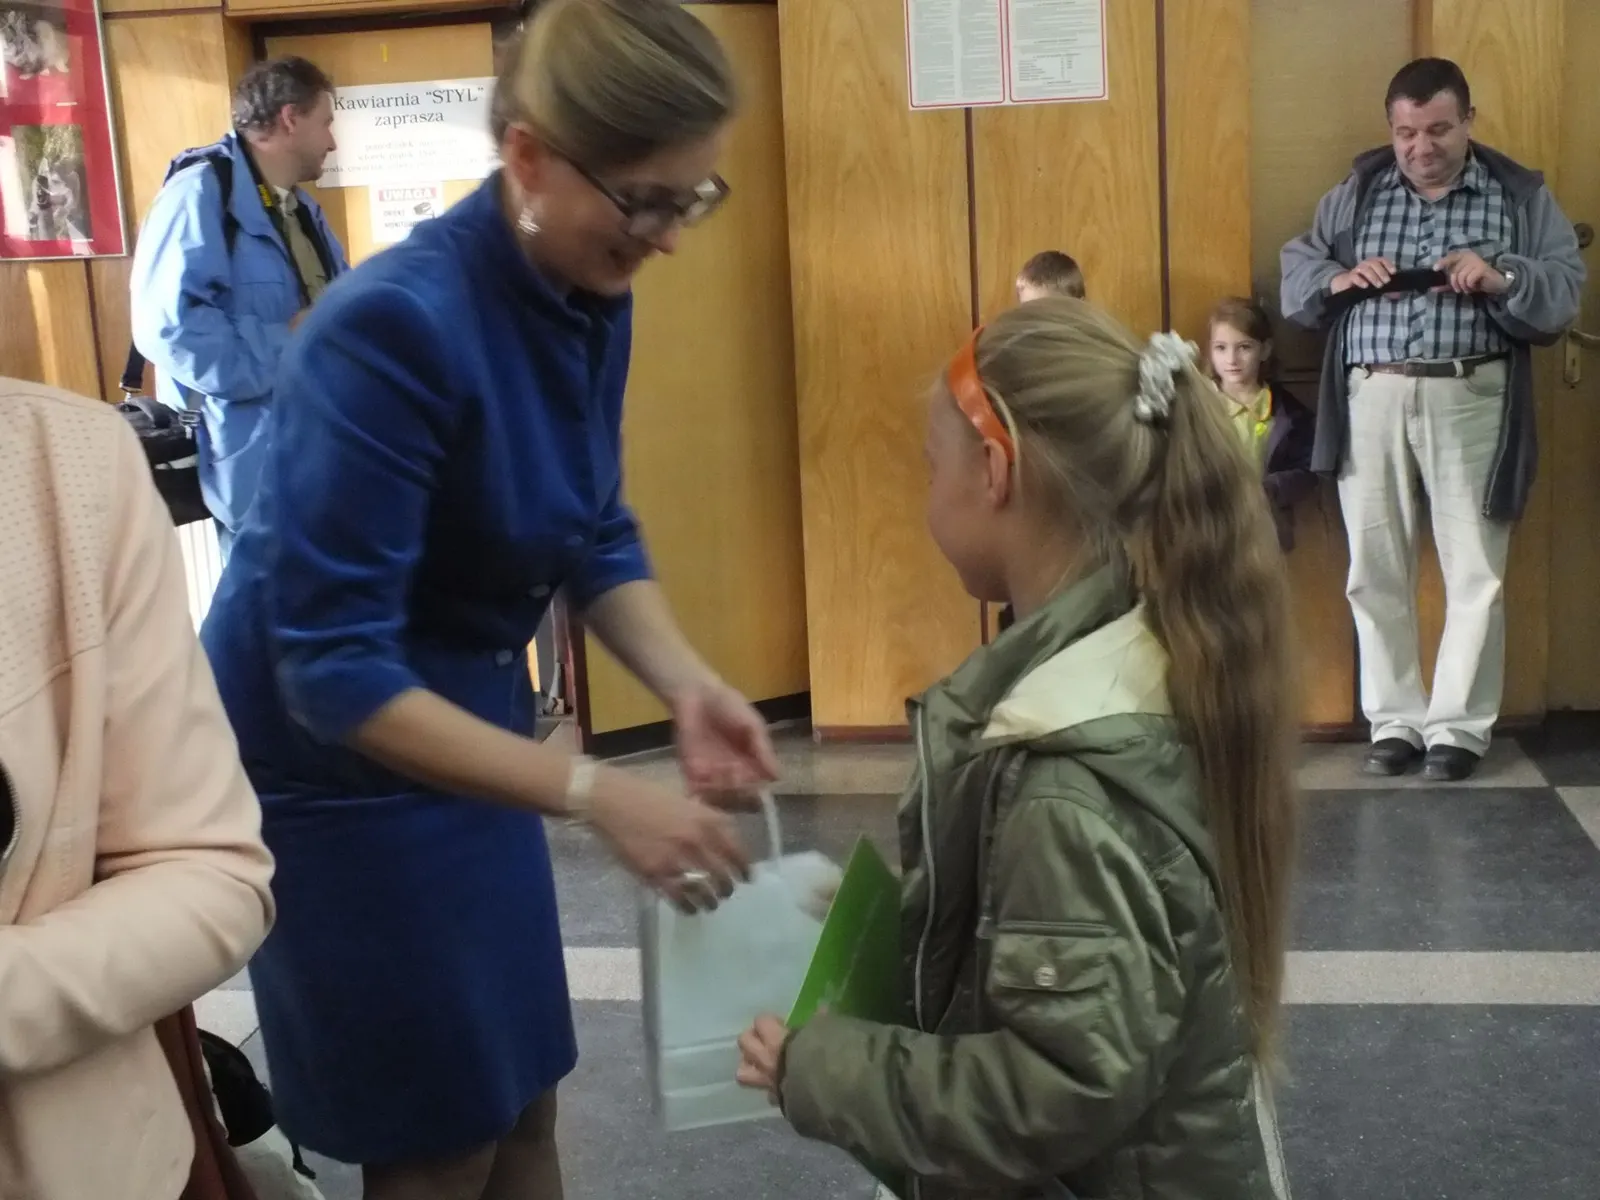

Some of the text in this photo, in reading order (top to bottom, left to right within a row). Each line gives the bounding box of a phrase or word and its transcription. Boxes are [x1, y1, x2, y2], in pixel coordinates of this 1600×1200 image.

[334, 93, 420, 111] Kawiarnia
[375, 111, 444, 129] zaprasza
[382, 188, 432, 201] UWAGA
